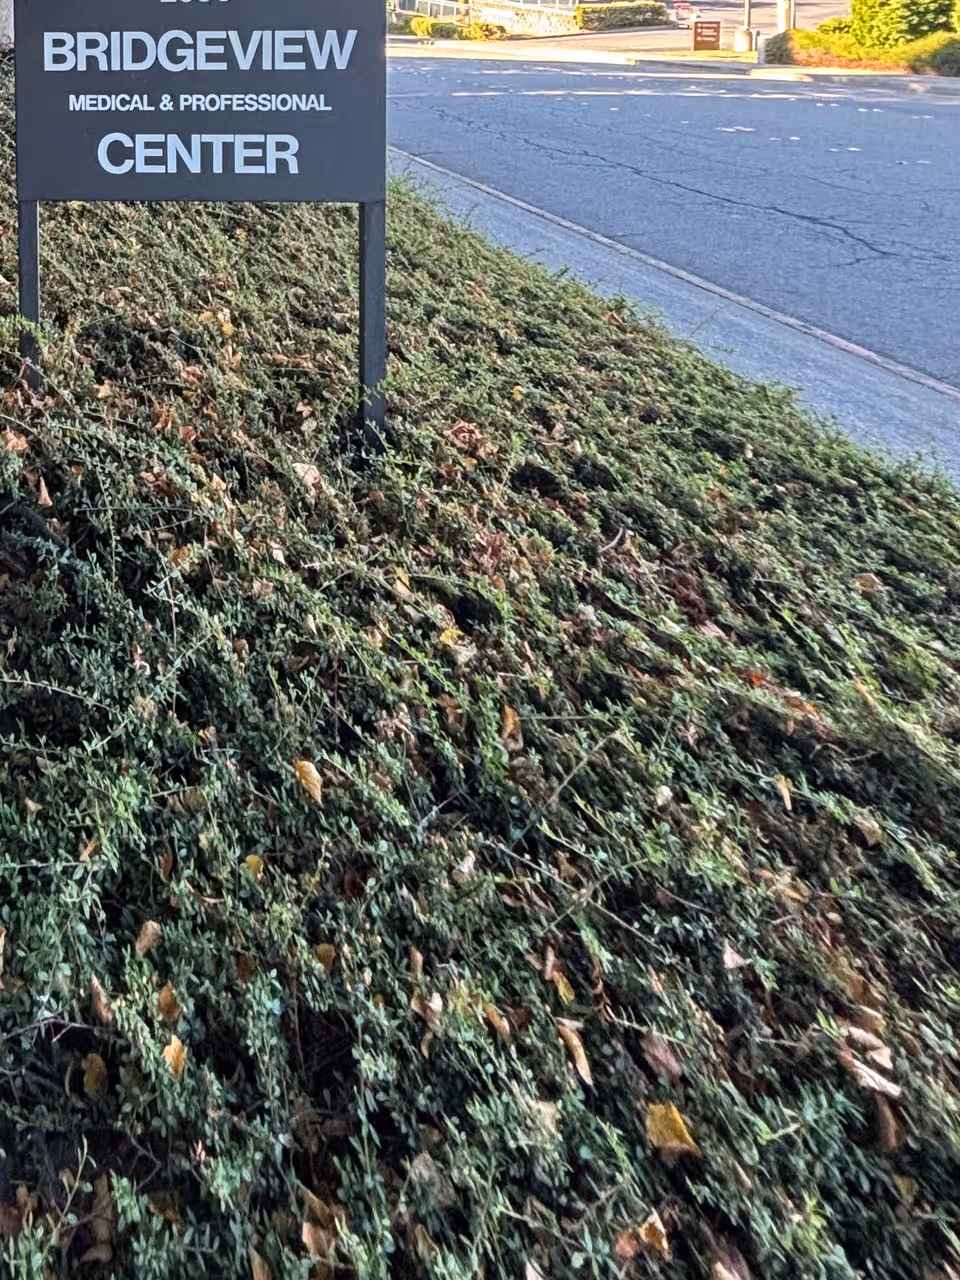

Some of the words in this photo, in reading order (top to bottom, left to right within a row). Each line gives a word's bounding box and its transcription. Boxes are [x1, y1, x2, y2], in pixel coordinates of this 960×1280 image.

[43, 29, 358, 73] BRIDGEVIEW
[68, 94, 156, 112] MEDICAL
[159, 94, 175, 112] &
[179, 93, 333, 112] PROFESSIONAL
[97, 132, 300, 175] CENTER
